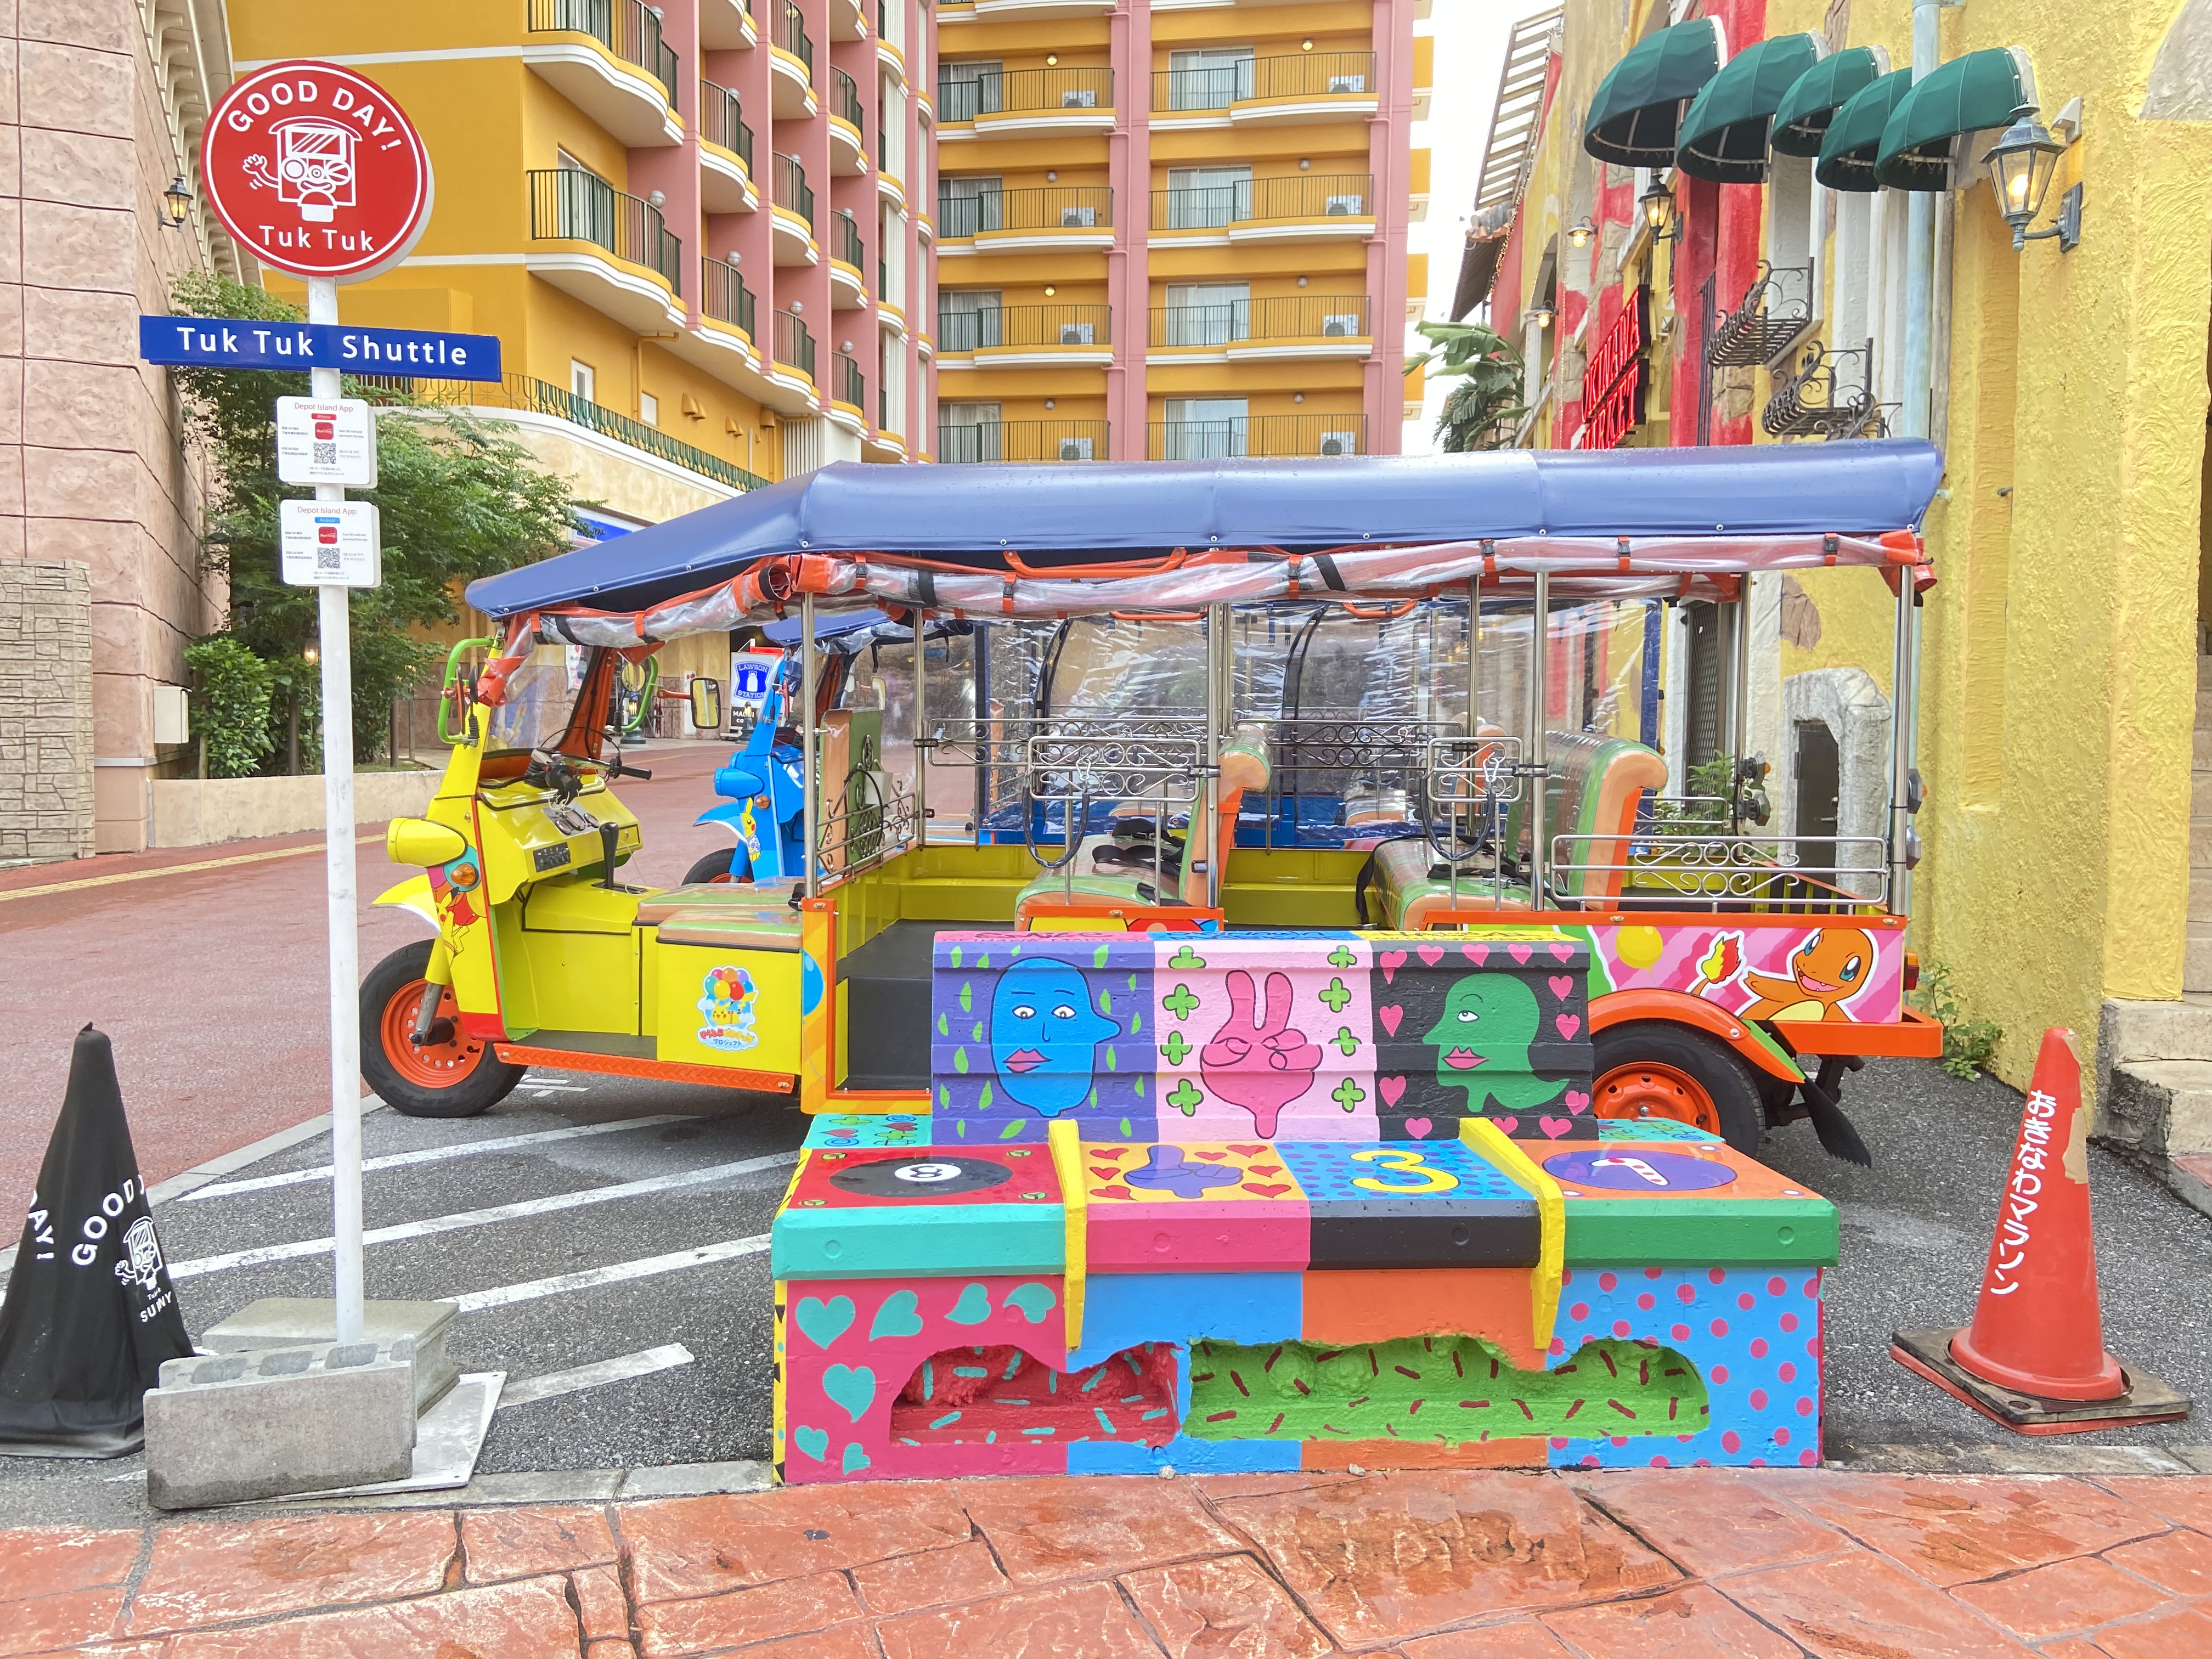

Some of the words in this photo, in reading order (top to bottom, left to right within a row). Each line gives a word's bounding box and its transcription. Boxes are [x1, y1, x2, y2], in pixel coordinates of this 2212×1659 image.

[228, 80, 318, 132] GOOD
[332, 87, 402, 151] DAY!
[259, 225, 311, 249] Tuk
[323, 228, 375, 252] Tuk
[177, 326, 239, 354] Tuk
[253, 330, 314, 357] Tuk
[342, 335, 467, 366] Shuttle
[1581, 289, 1640, 423] OKINAWA
[294, 402, 315, 411] Depot
[339, 405, 353, 413] App
[297, 506, 319, 515] Depot
[738, 664, 768, 673] LAWSON
[713, 1038, 742, 1046] プロジェクト
[910, 1165, 944, 1178] 8
[1350, 1149, 1460, 1193] 3
[28, 1189, 54, 1261] AY!
[72, 1178, 134, 1266] GOOD
